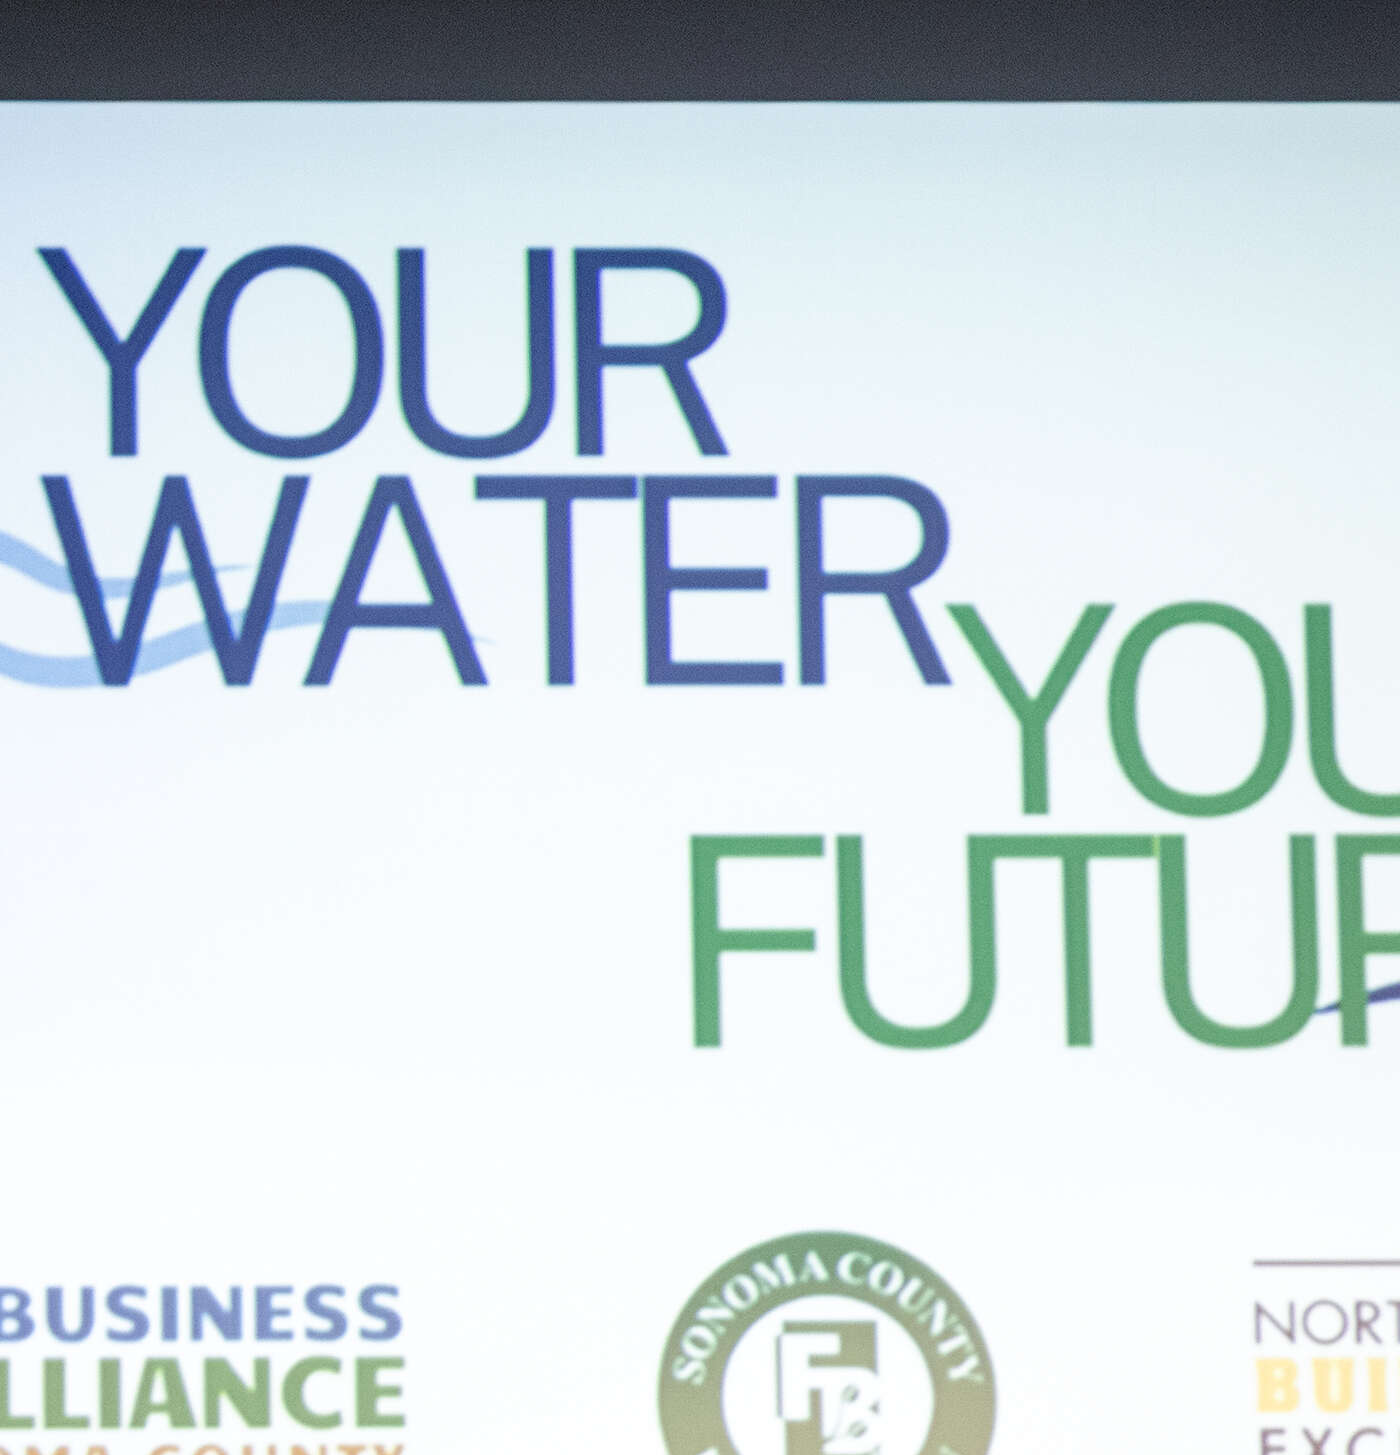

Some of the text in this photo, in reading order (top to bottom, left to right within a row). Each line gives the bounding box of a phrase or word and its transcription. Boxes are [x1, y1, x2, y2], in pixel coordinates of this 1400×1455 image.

[36, 244, 731, 460] YOUR
[39, 474, 953, 688] WATER
[671, 1250, 985, 1386] SONOMA COUNTY
